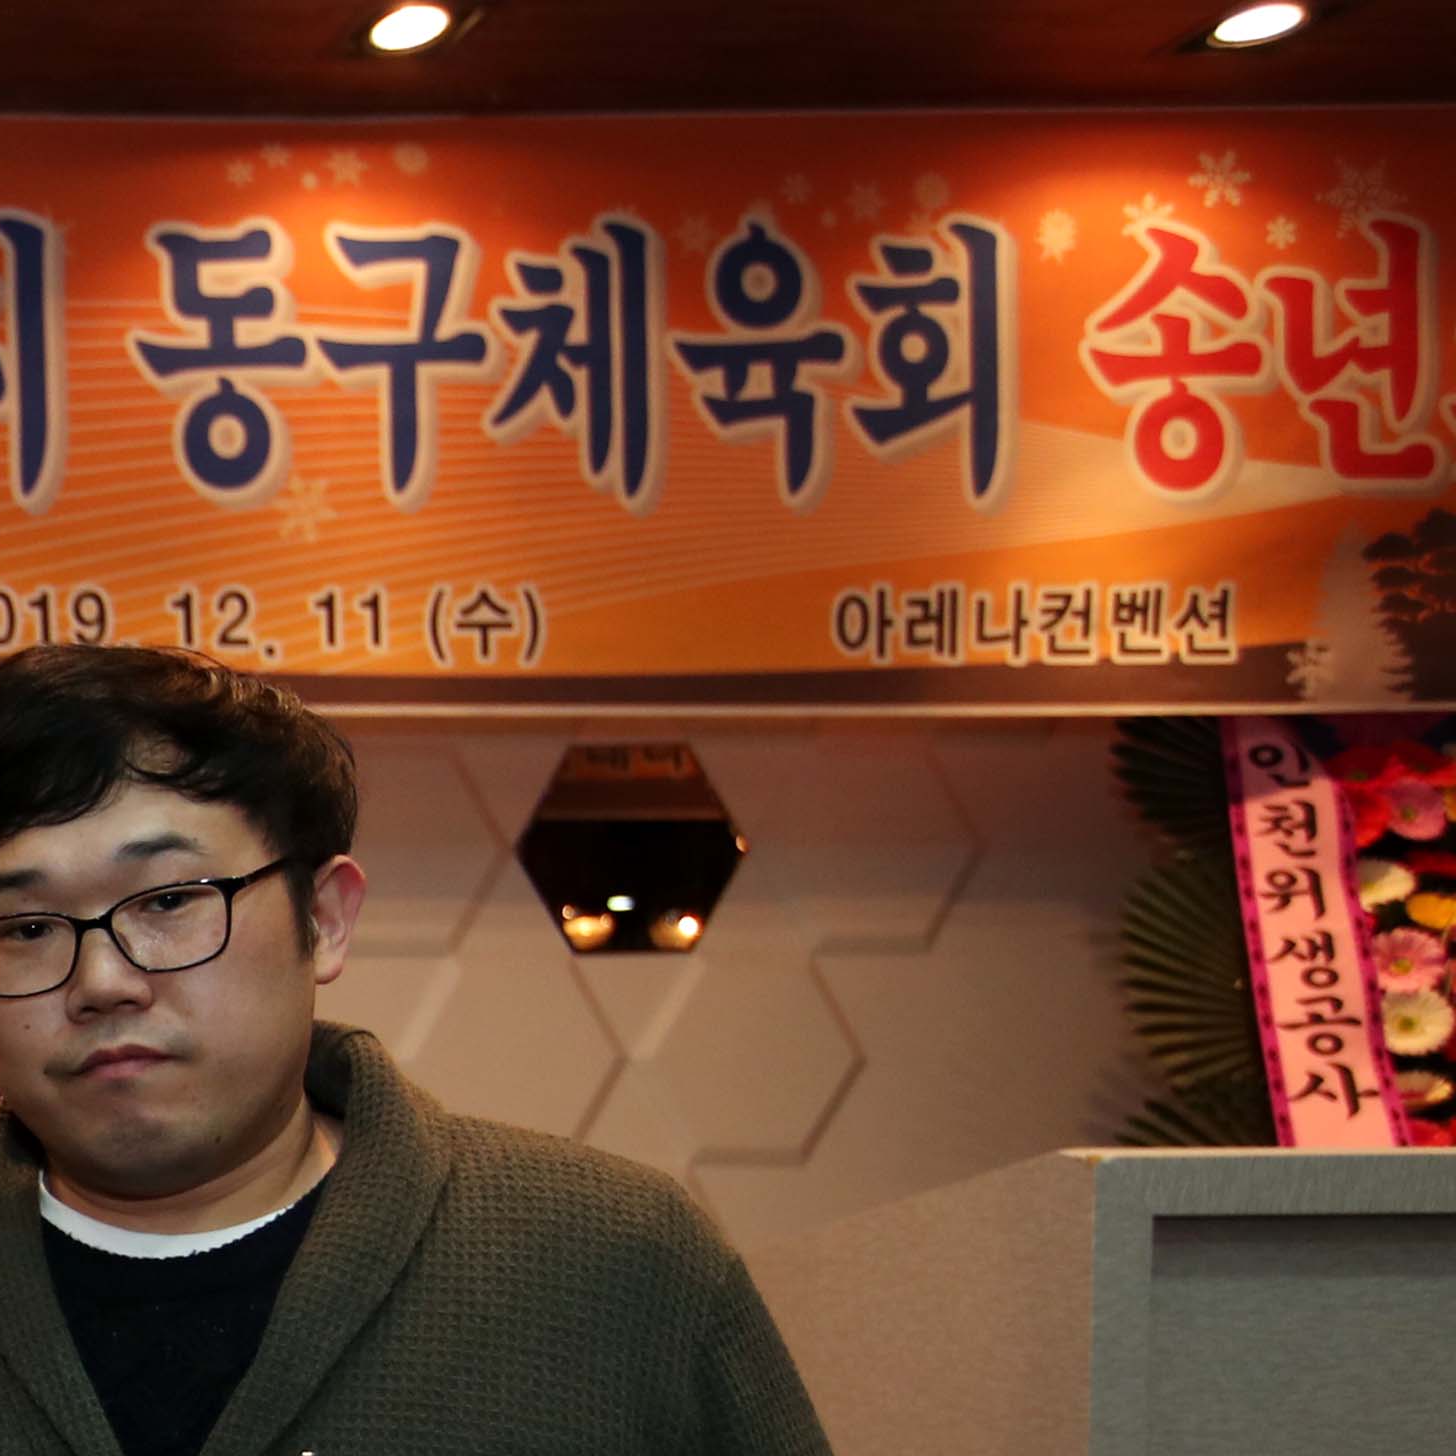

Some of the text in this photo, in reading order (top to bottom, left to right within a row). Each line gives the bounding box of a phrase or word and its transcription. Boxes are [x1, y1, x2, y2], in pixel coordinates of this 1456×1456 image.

[141, 216, 1000, 502] 동구체육회
[1090, 215, 1456, 492] 송년
[171, 590, 277, 658] 12.
[315, 590, 387, 648] 11
[428, 588, 541, 662] (수)
[835, 586, 1233, 658] 아레나컨벤션
[1249, 744, 1380, 1118] 인천위생공사
